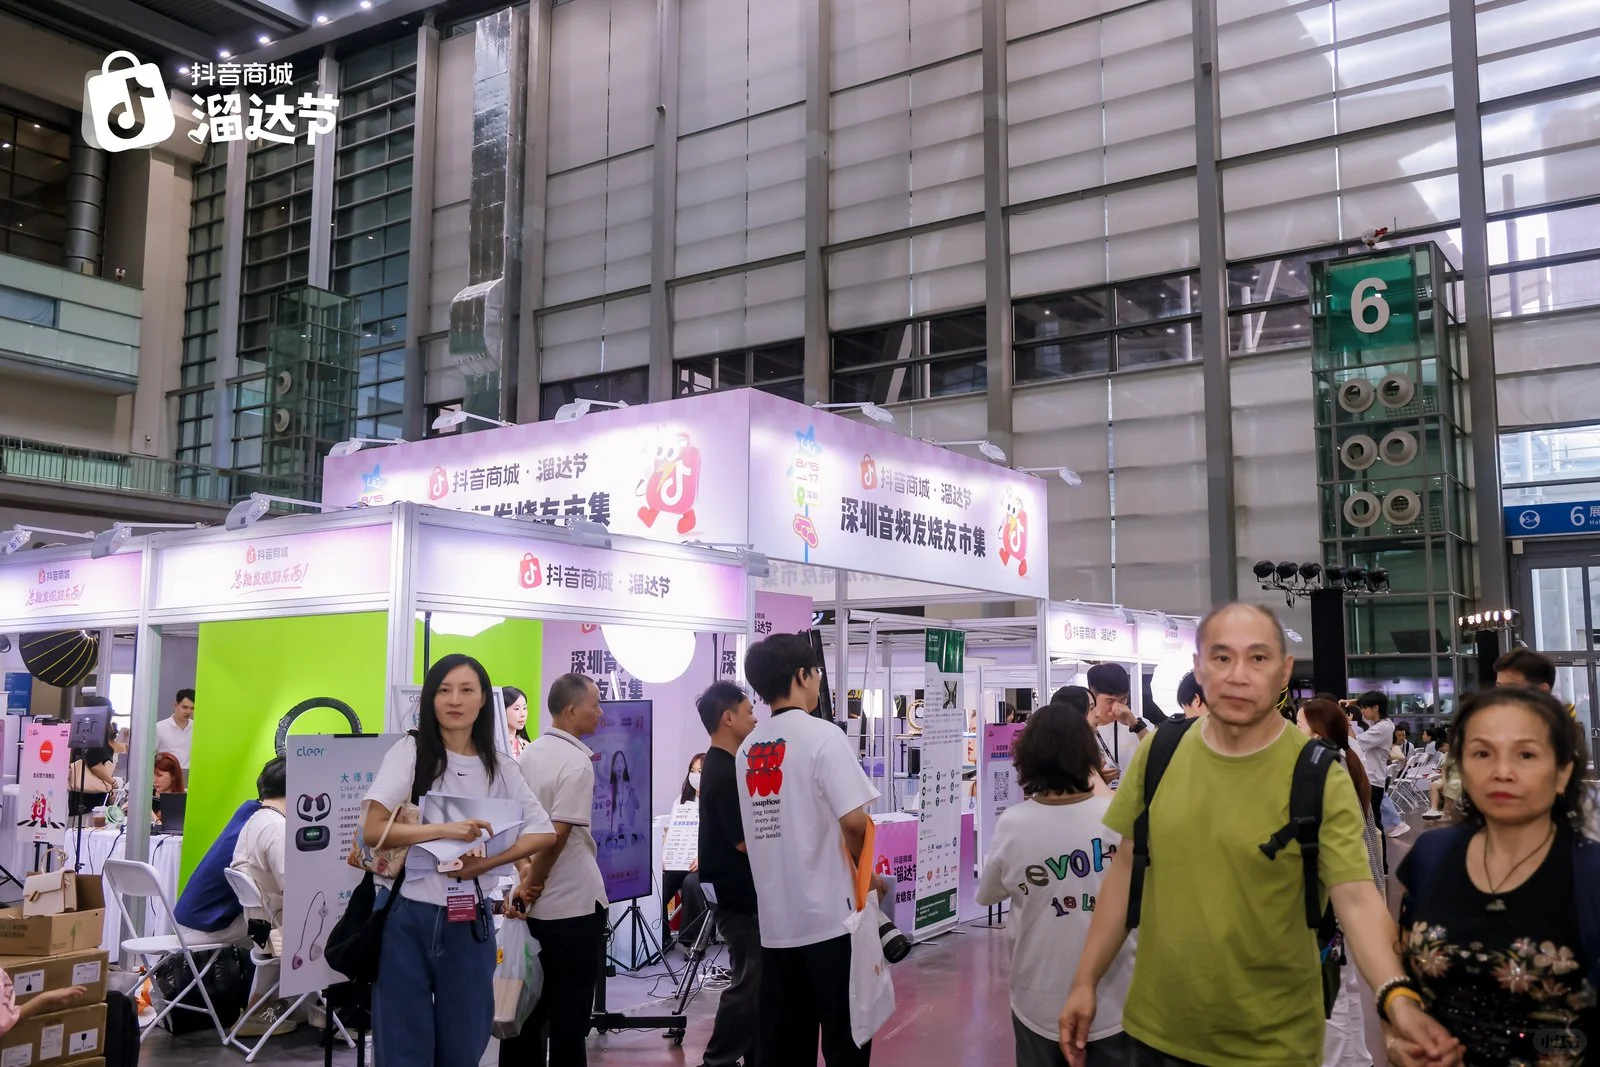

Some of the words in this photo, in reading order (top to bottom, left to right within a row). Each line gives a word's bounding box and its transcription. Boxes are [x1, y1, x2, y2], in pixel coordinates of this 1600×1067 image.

[1351, 277, 1390, 333] 6
[795, 458, 820, 472] 8/15
[1570, 505, 1585, 526] 6
[840, 496, 986, 558] 深圳音频发烧友市集
[258, 546, 289, 561] 抖音商城
[47, 569, 70, 581] 抖音商城
[571, 650, 625, 675] 深圳音
[296, 746, 325, 757] cleer
